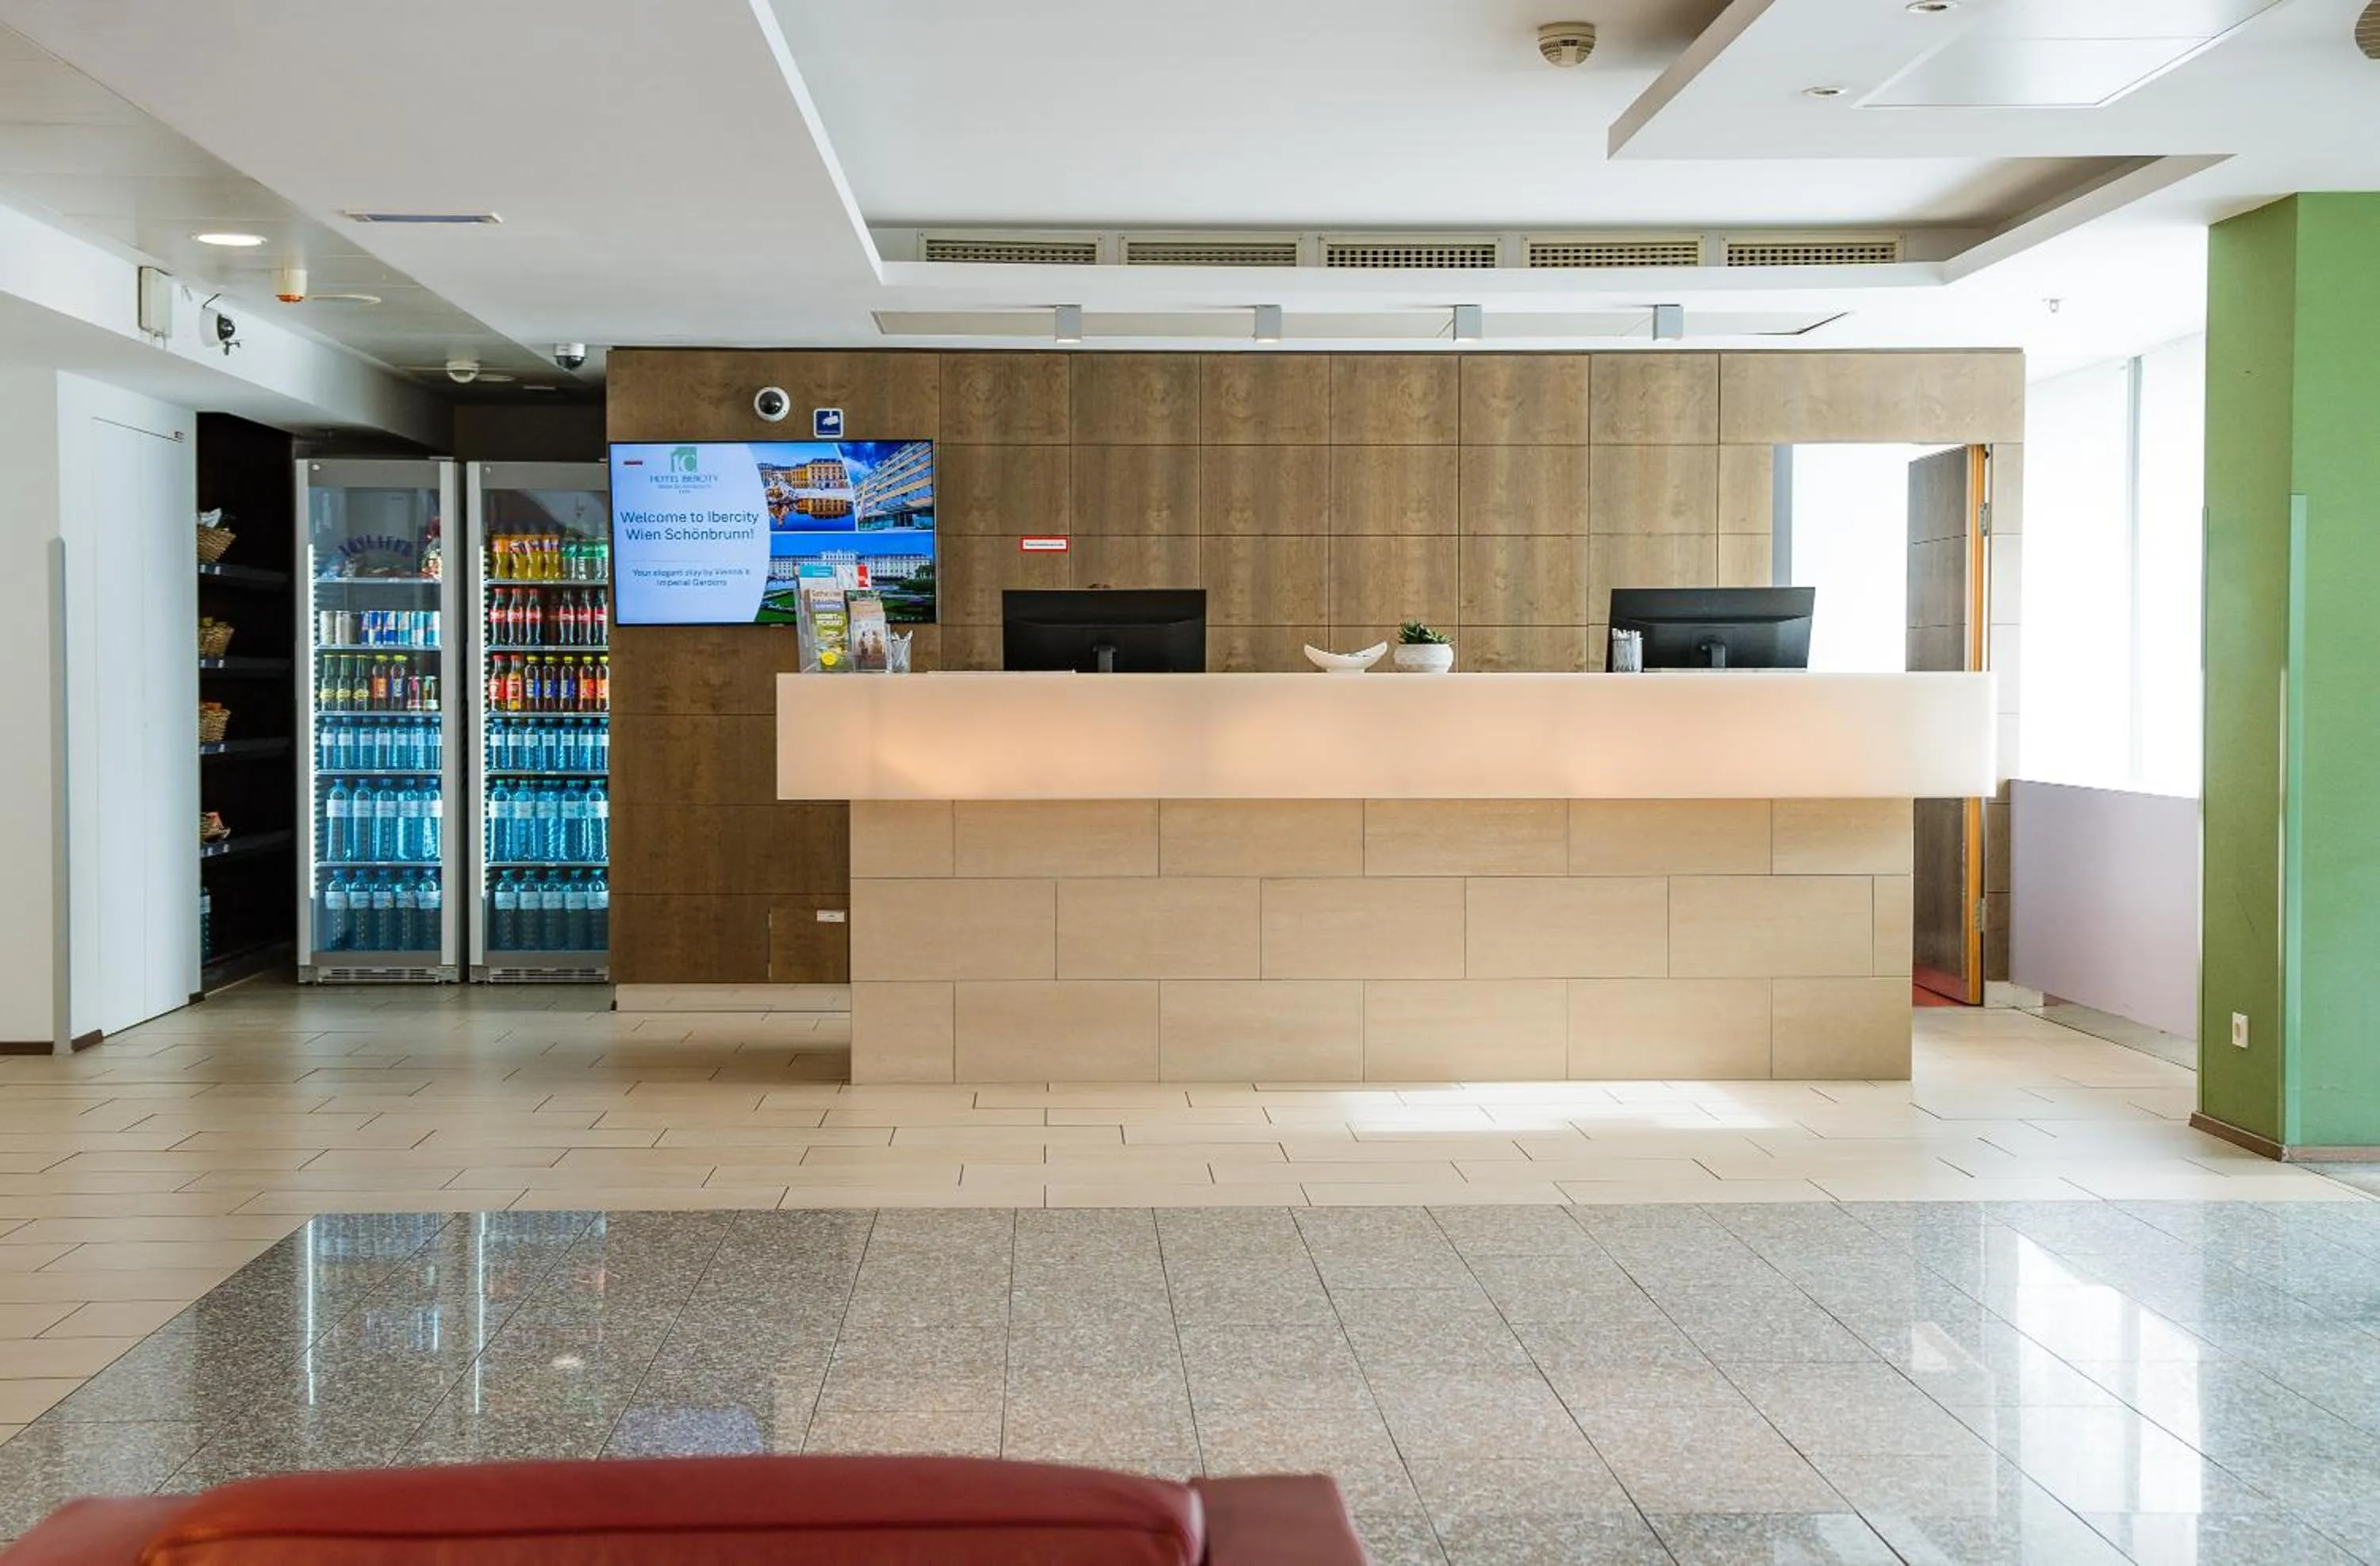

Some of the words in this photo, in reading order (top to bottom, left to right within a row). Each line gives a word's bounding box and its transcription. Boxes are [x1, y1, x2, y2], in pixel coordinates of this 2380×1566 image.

[650, 474, 679, 483] HOTEL
[620, 511, 686, 524] Welcome
[690, 512, 704, 524] to
[708, 510, 759, 524] Ibercity
[626, 528, 661, 540] Wien
[665, 528, 754, 540] Schönbrunn!
[632, 569, 651, 578] Your
